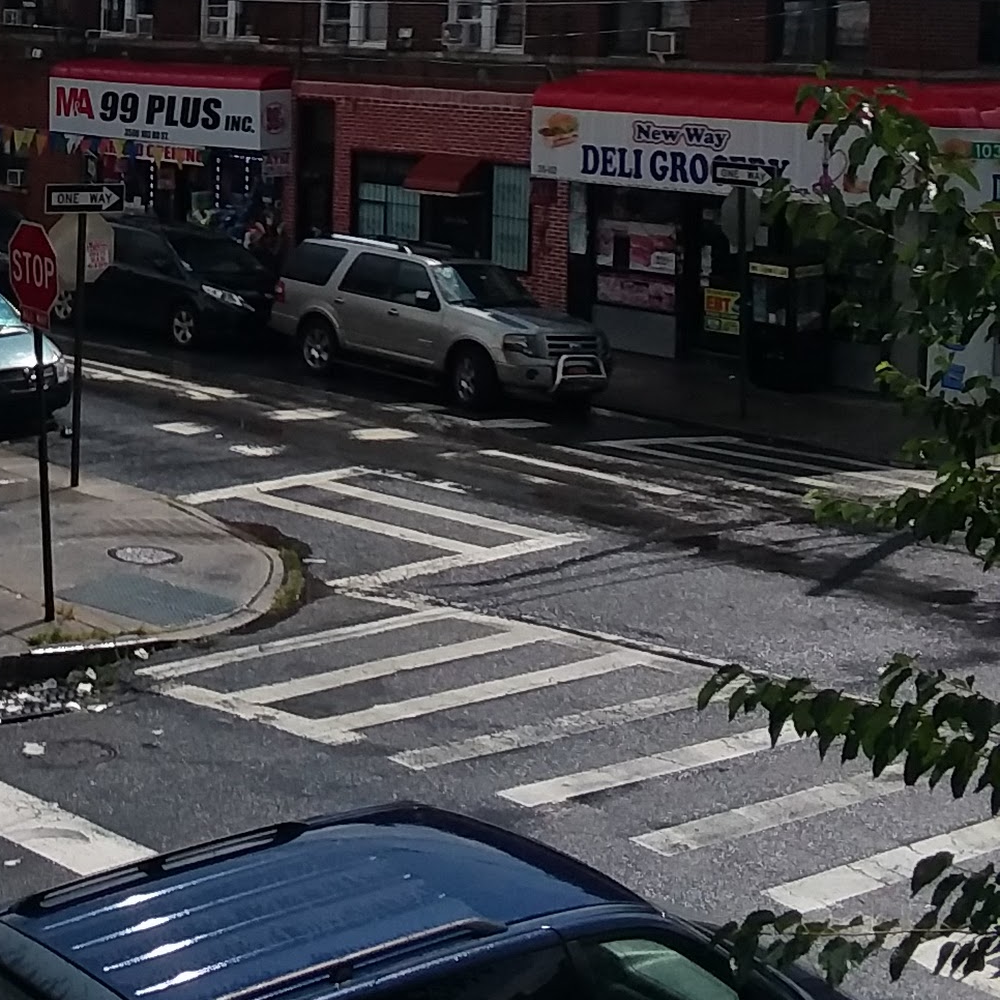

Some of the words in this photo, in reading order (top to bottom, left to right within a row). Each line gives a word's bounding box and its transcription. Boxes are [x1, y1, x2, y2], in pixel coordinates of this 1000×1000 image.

[100, 92, 139, 122] 99
[146, 94, 222, 130] PLUS
[225, 115, 255, 133] INC.
[636, 124, 680, 145] New
[685, 126, 729, 149] Way
[581, 145, 643, 179] DELI
[649, 150, 790, 187] GROY
[721, 169, 739, 178] ONE
[747, 171, 766, 181] WAY
[57, 193, 79, 204] ONE
[89, 193, 112, 204] WAY
[12, 248, 55, 289] STOP
